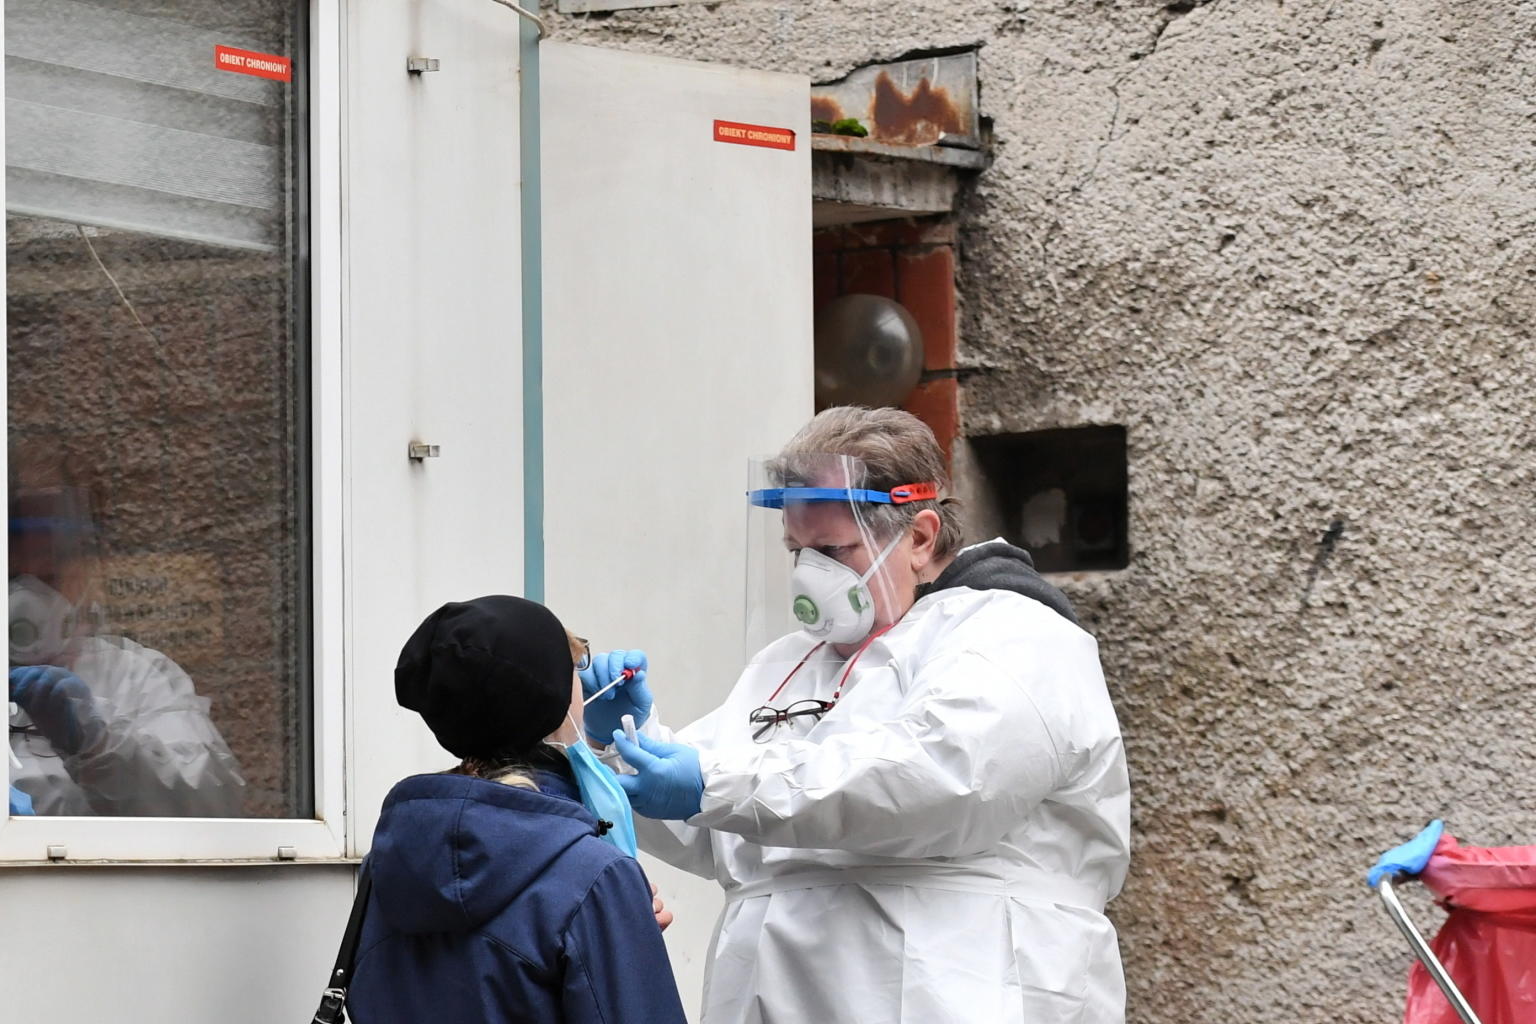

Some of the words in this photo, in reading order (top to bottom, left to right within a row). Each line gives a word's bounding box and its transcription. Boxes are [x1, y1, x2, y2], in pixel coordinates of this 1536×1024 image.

[219, 52, 245, 66] OBIEKT
[246, 58, 287, 74] CHRONIONY
[718, 127, 746, 138] OBIEKT
[747, 130, 792, 145] CHRONIONY
